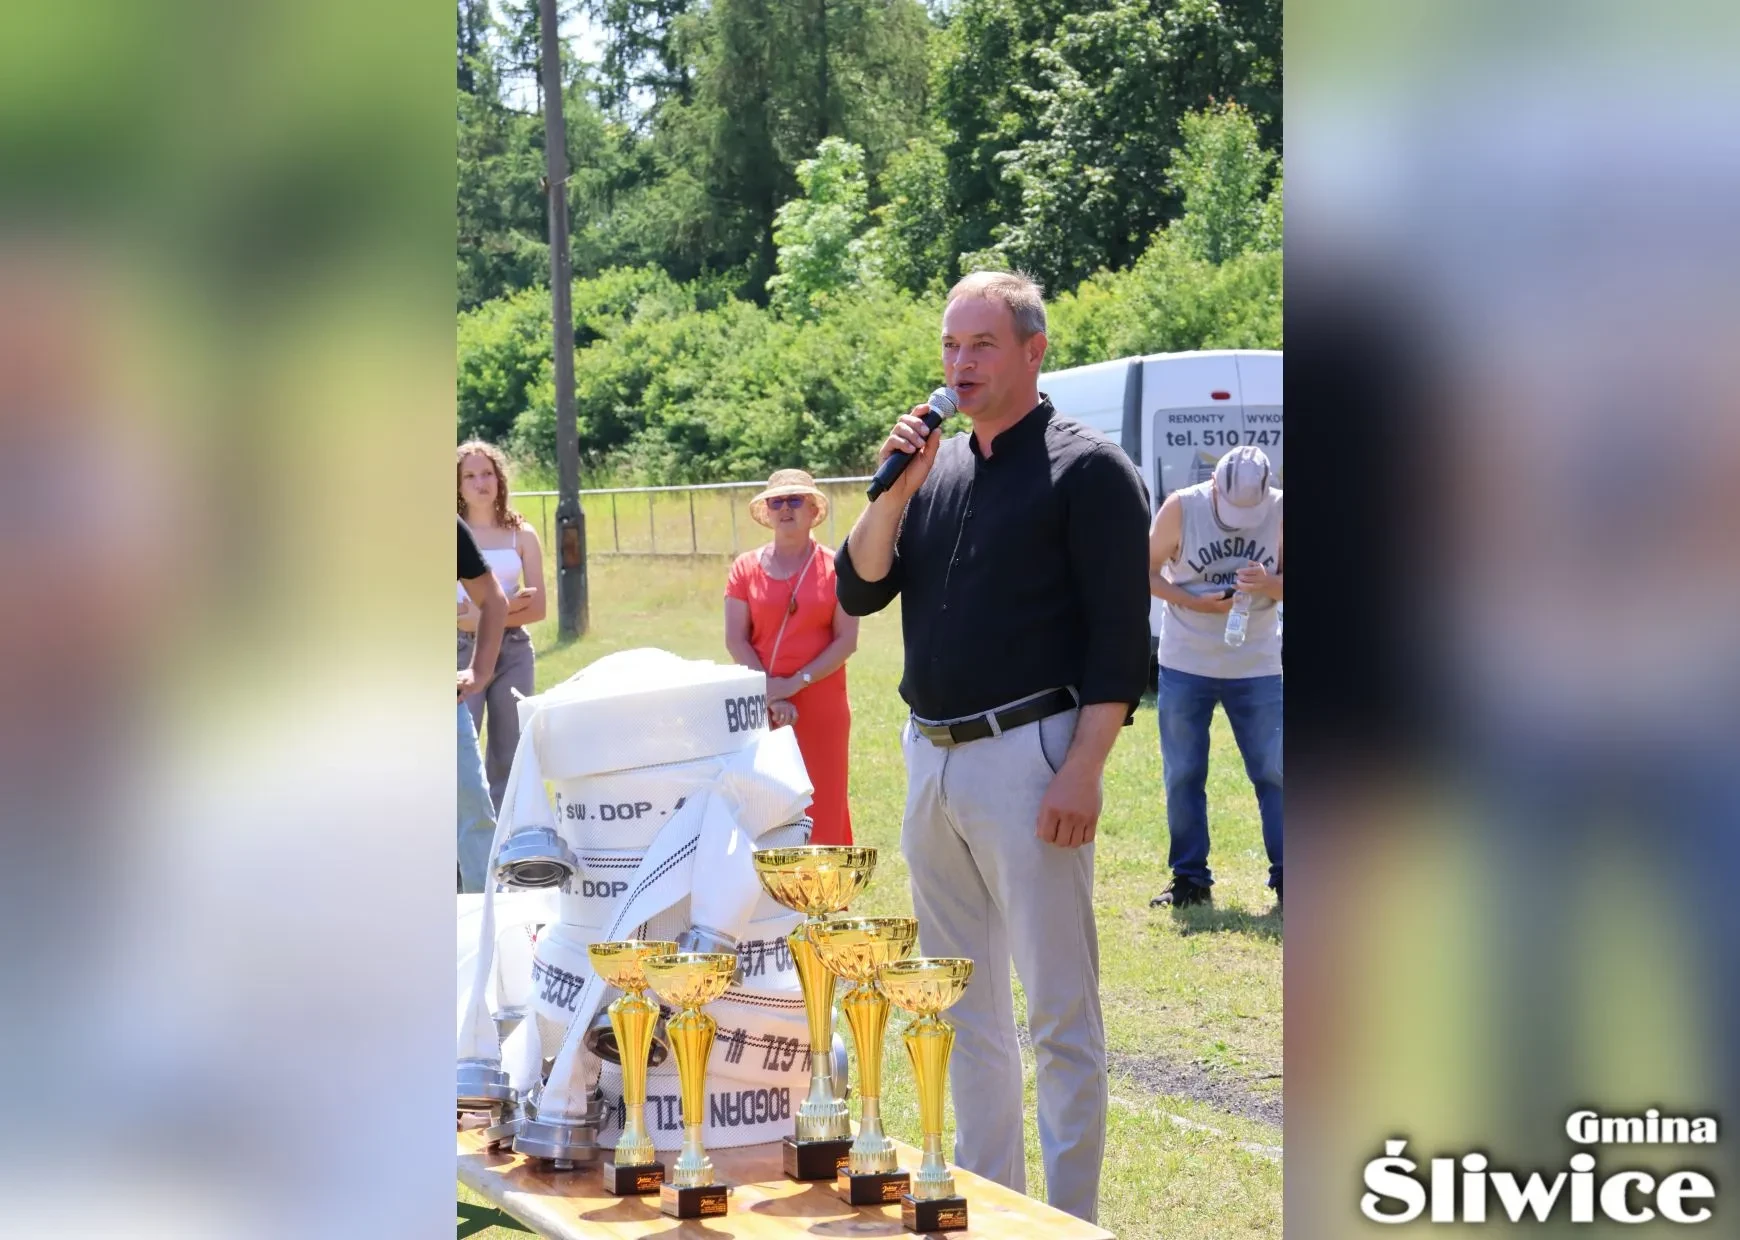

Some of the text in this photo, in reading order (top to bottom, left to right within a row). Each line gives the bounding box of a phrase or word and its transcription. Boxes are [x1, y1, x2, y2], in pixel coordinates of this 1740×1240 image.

[1168, 414, 1225, 424] REMONTY
[1166, 430, 1281, 447] tel. 510 747
[762, 1034, 799, 1072] GIL
[710, 1087, 791, 1128] BOGDAN
